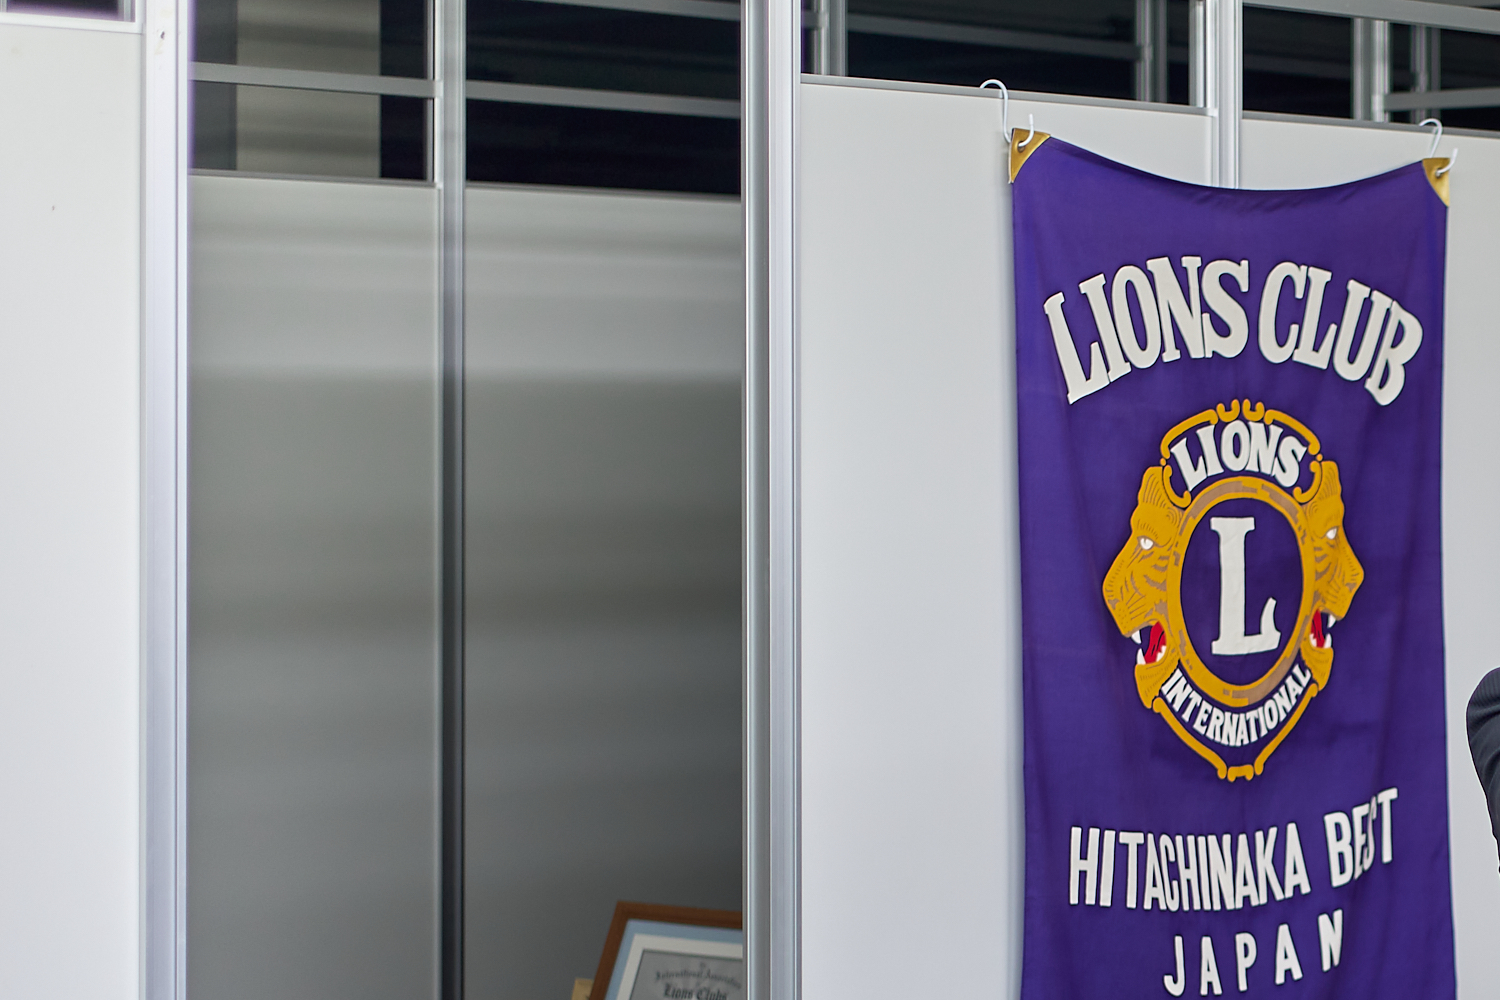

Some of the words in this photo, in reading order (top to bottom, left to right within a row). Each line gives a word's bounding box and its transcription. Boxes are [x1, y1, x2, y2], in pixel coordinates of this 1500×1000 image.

[1043, 256, 1249, 405] LIONS
[1258, 261, 1423, 406] CLUB
[1170, 419, 1307, 492] LIONS
[1210, 517, 1281, 656] L
[1161, 663, 1312, 747] INTERNATIONAL
[1069, 822, 1311, 912] HITACHINAKA
[1323, 787, 1398, 888] BEST
[663, 982, 694, 1000] Lions
[1163, 909, 1343, 997] JAPAN
